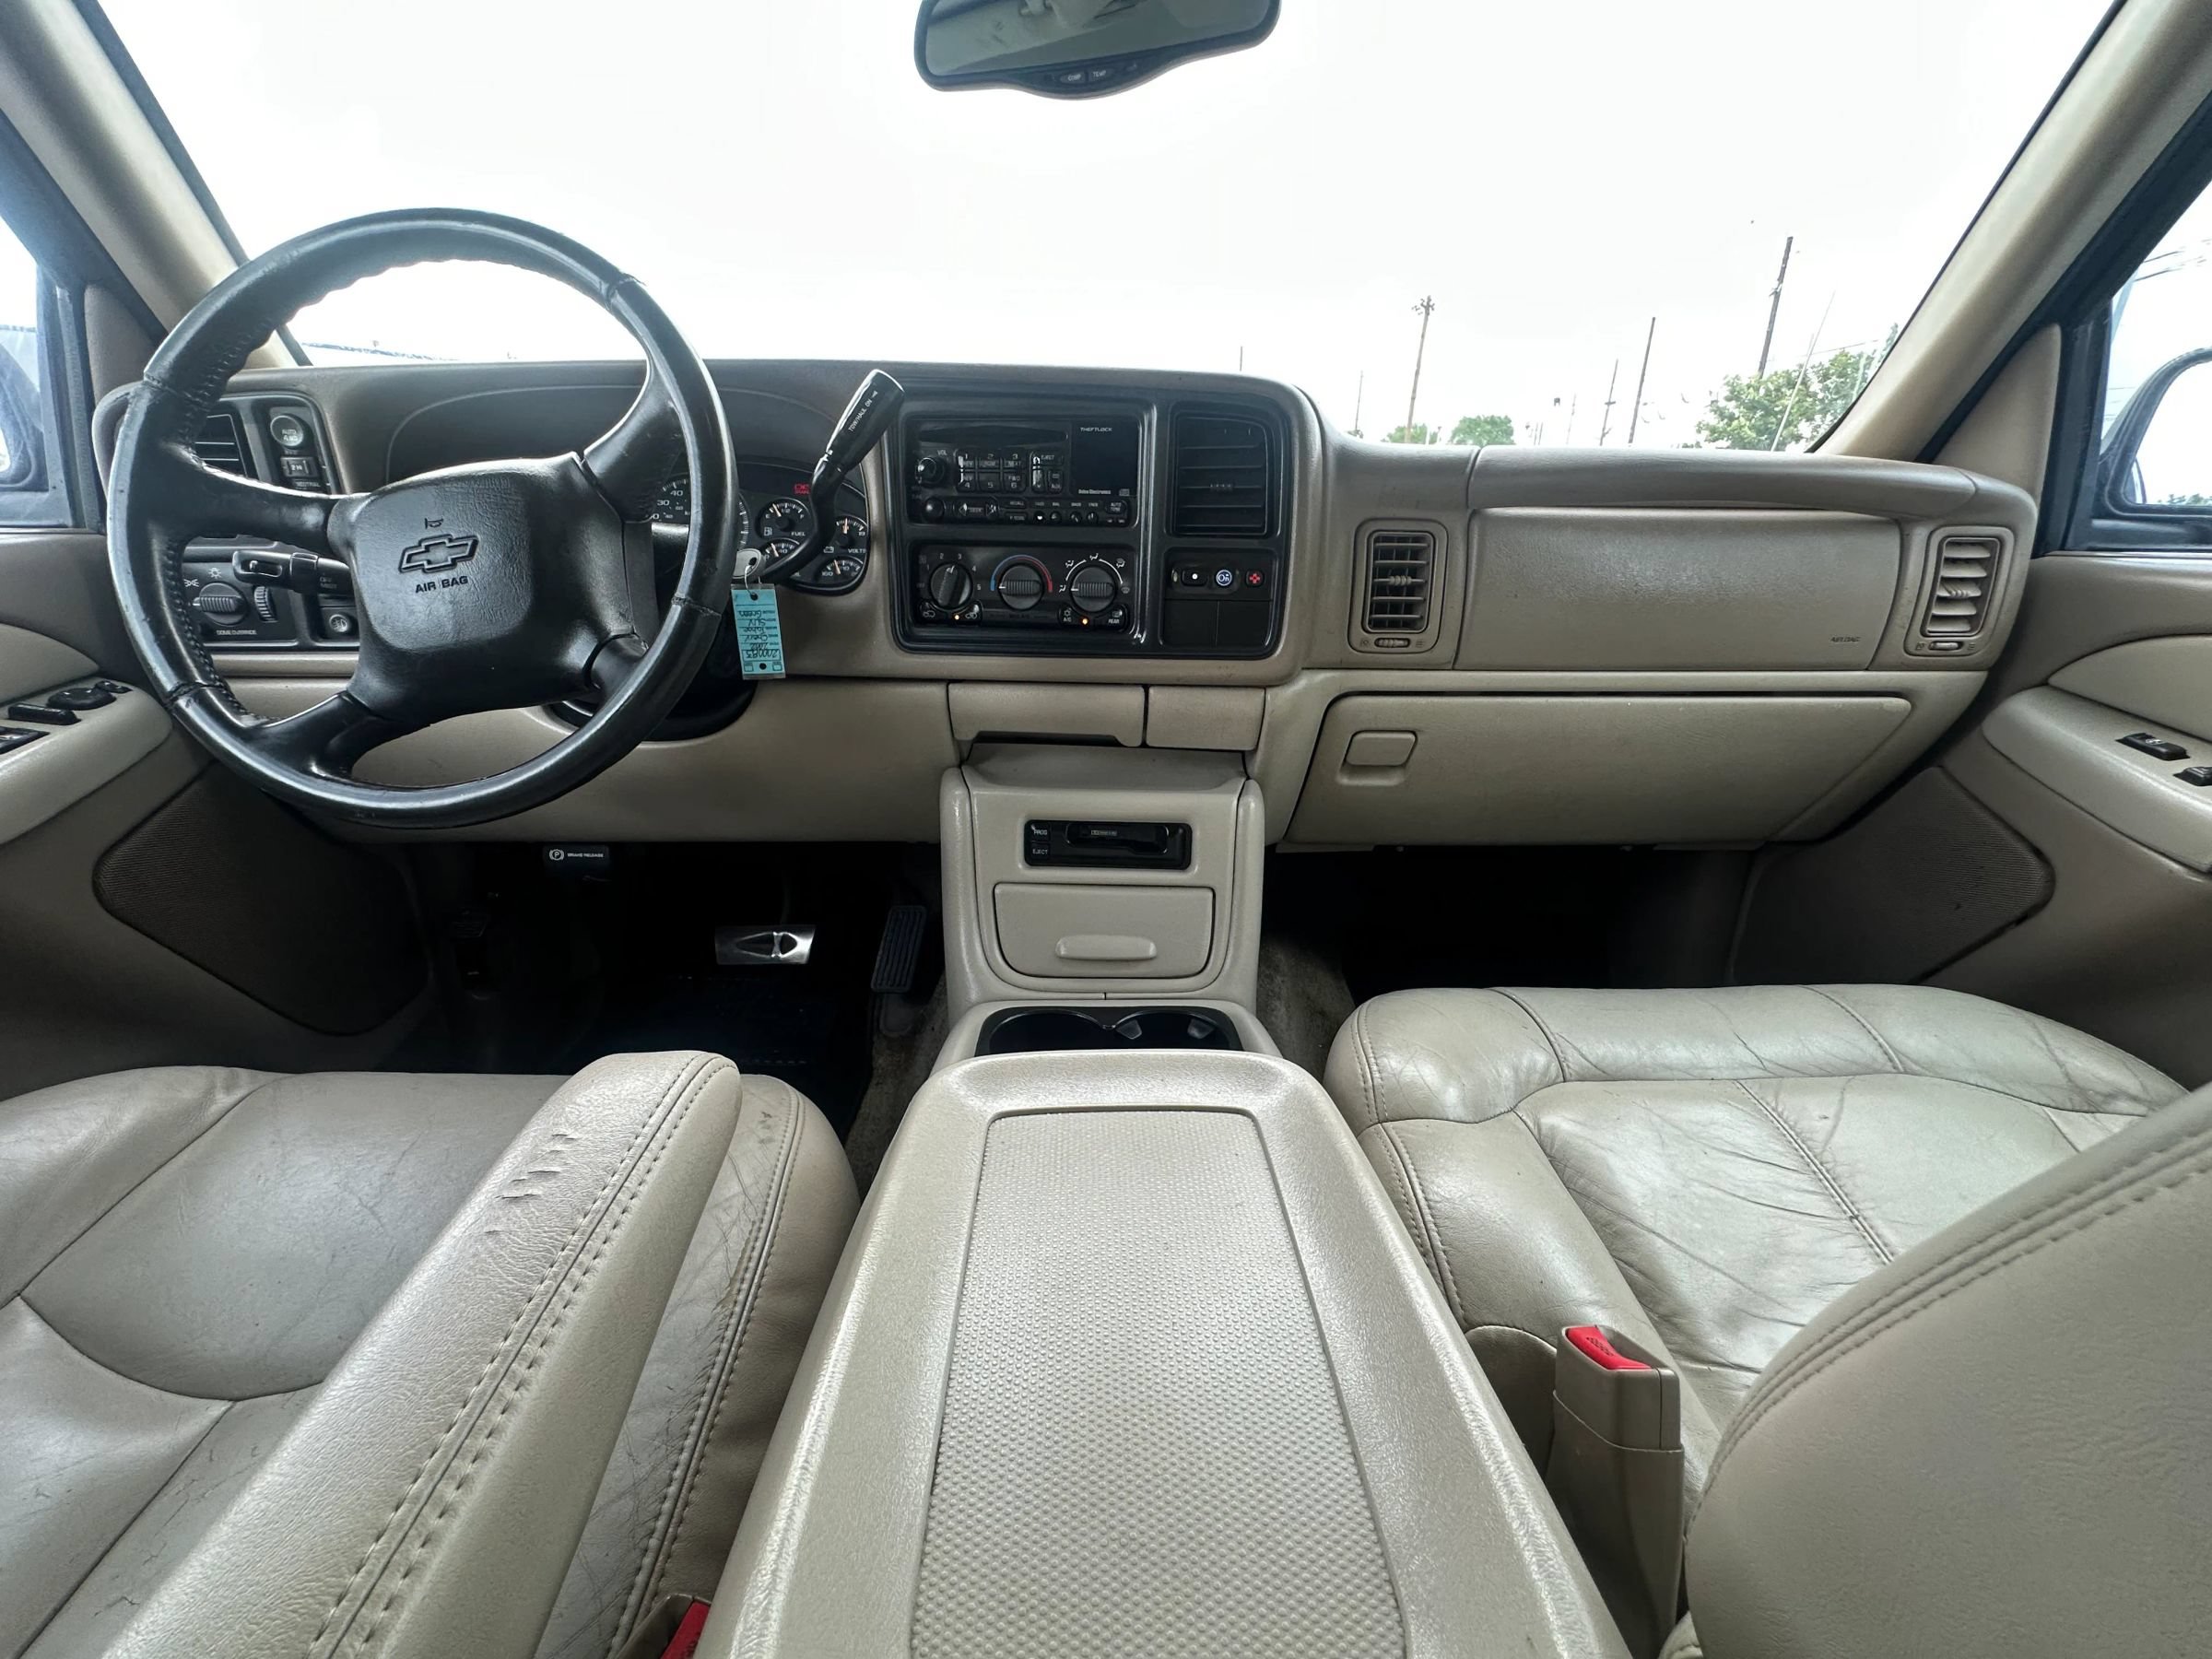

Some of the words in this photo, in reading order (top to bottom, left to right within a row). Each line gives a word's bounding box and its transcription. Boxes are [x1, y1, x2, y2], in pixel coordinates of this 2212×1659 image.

[848, 407, 867, 432] TOW/HAUL
[416, 582, 437, 594] AIR
[441, 575, 469, 589] BAG
